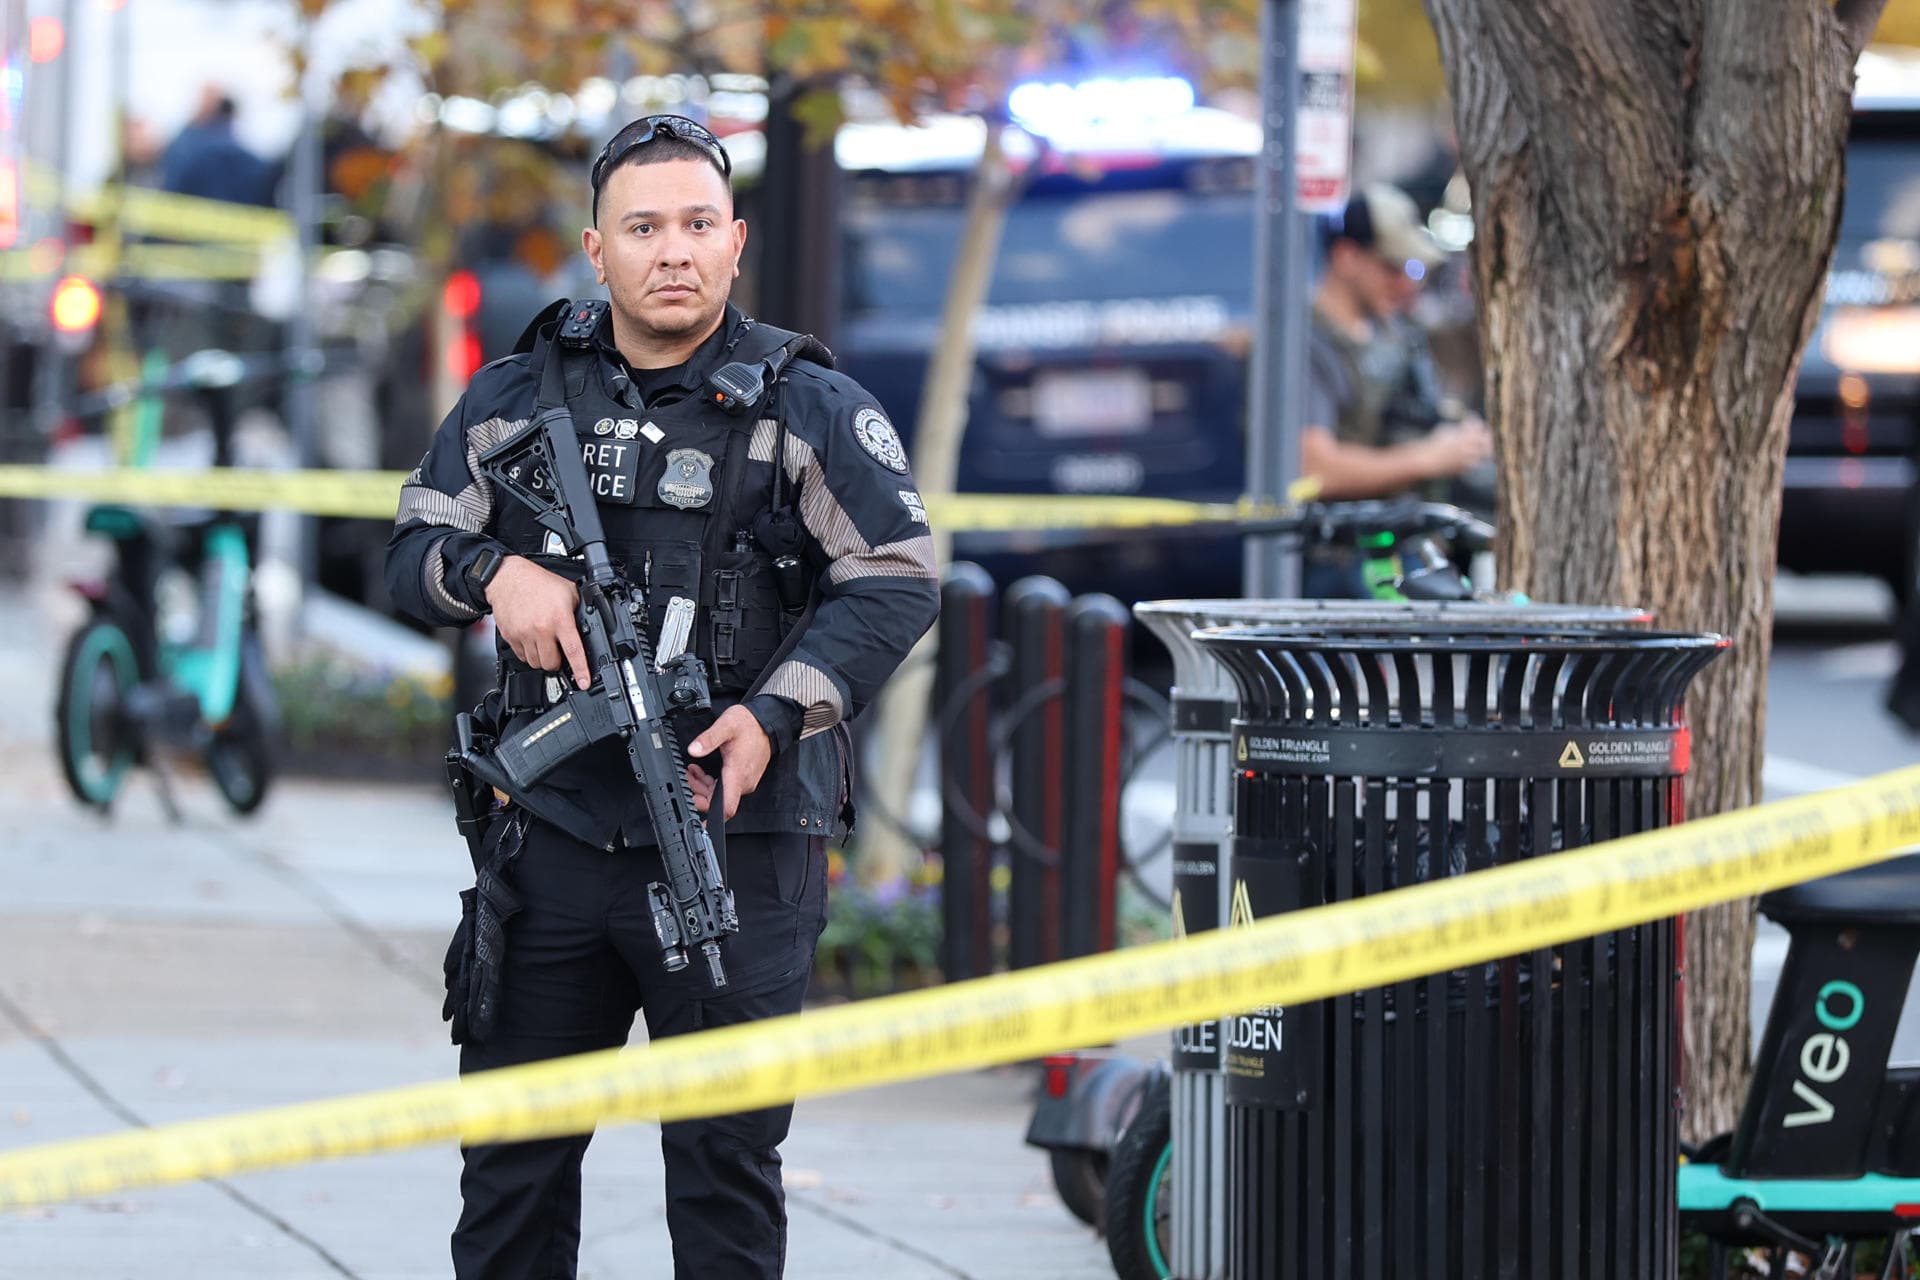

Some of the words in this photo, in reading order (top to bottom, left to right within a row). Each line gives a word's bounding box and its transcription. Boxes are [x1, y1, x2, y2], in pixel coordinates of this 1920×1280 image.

[582, 443, 627, 468] RET
[1249, 736, 1280, 750] GOLDEN
[1281, 739, 1330, 753] TRIANGLE
[1588, 742, 1631, 755] GOLDEN
[1782, 979, 1865, 1129] veo
